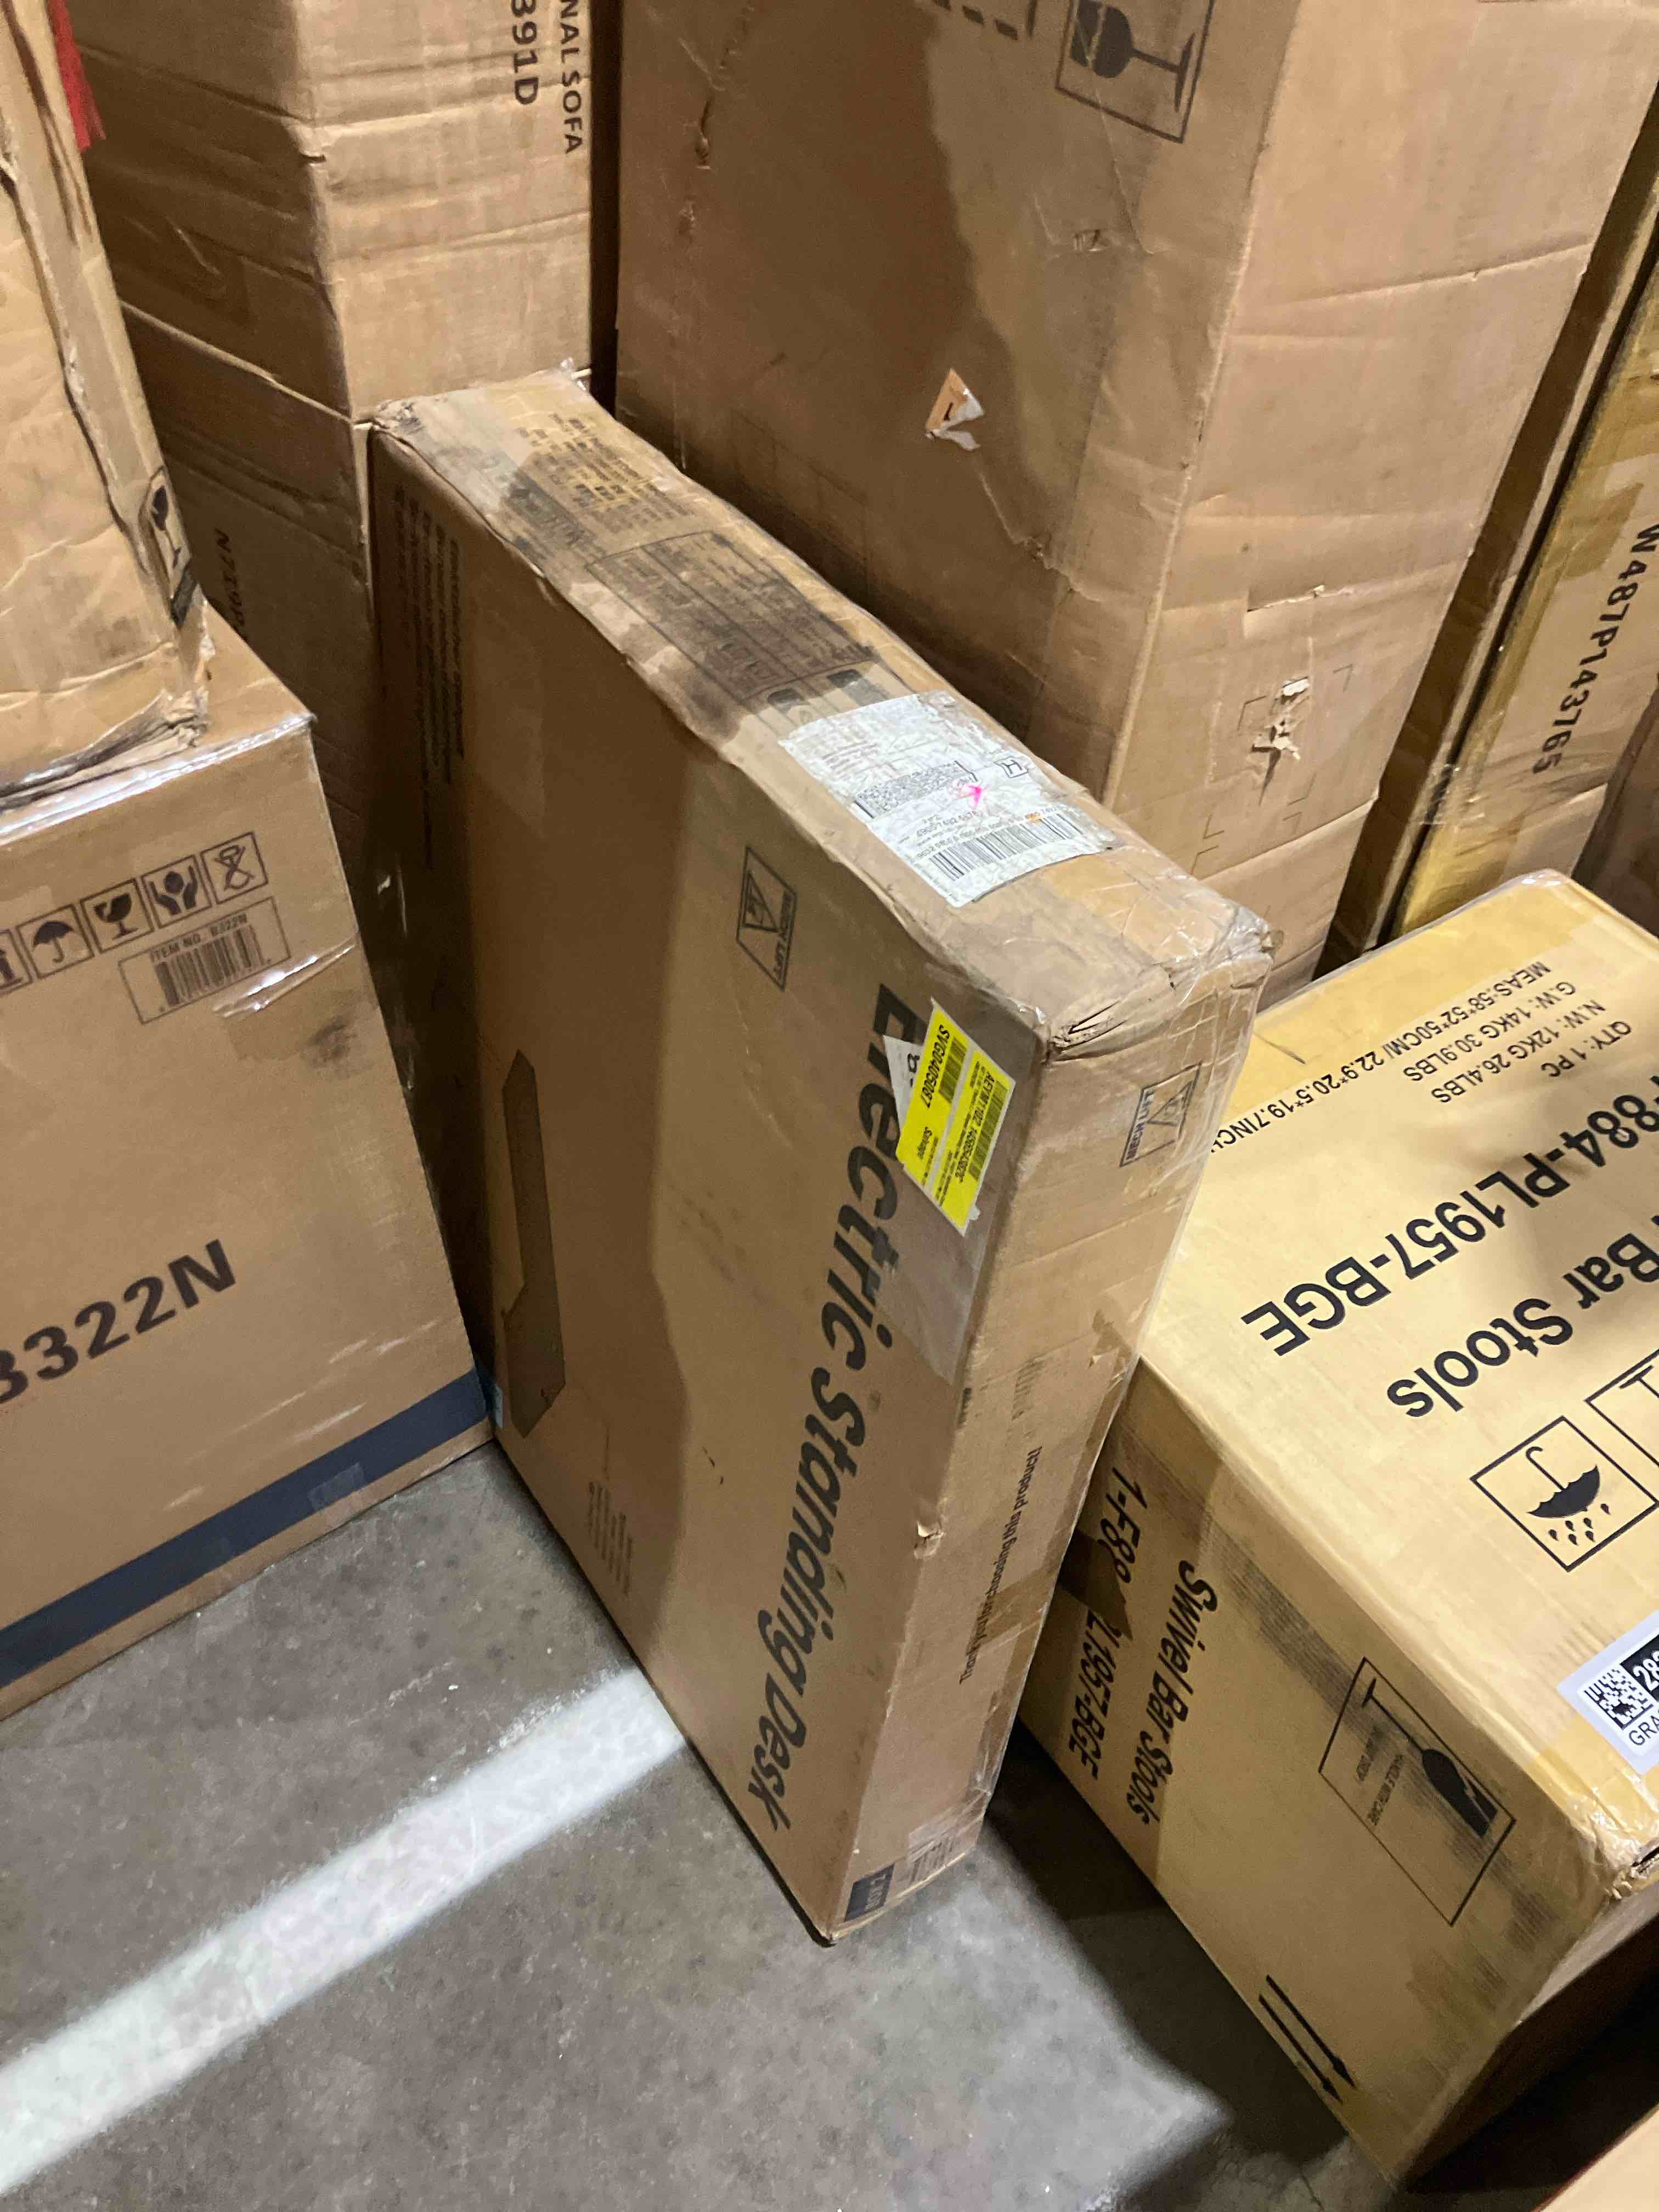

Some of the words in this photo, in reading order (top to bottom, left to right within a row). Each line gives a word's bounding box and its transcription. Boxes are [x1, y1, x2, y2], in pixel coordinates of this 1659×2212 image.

[562, 71, 583, 154] SOFA
[1532, 523, 1659, 774] W487P143765
[1402, 1031, 1485, 1082] 30.9LBS
[1482, 1004, 1532, 1040] 14KG
[1515, 1024, 1561, 1060] 12KG
[1571, 1046, 1588, 1062] 1
[1581, 1019, 1633, 1052] QTY:
[1430, 1051, 1514, 1104] 26.4LBS
[1539, 1053, 1576, 1079] PC
[1562, 1233, 1659, 1311] Bar
[1386, 1297, 1574, 1418] Stools
[758, 1366, 866, 1697] Standing
[958, 1644, 980, 1685] Thank
[985, 1535, 1017, 1595] choosing
[1003, 1511, 1022, 1539] this
[1013, 1446, 1042, 1510] product!
[1158, 1560, 1218, 1696] Swivel
[1146, 1669, 1189, 1745] Bar
[1628, 1709, 1659, 1746] GRA
[747, 1671, 807, 1832] Desk
[1126, 1730, 1174, 1826] Stools
